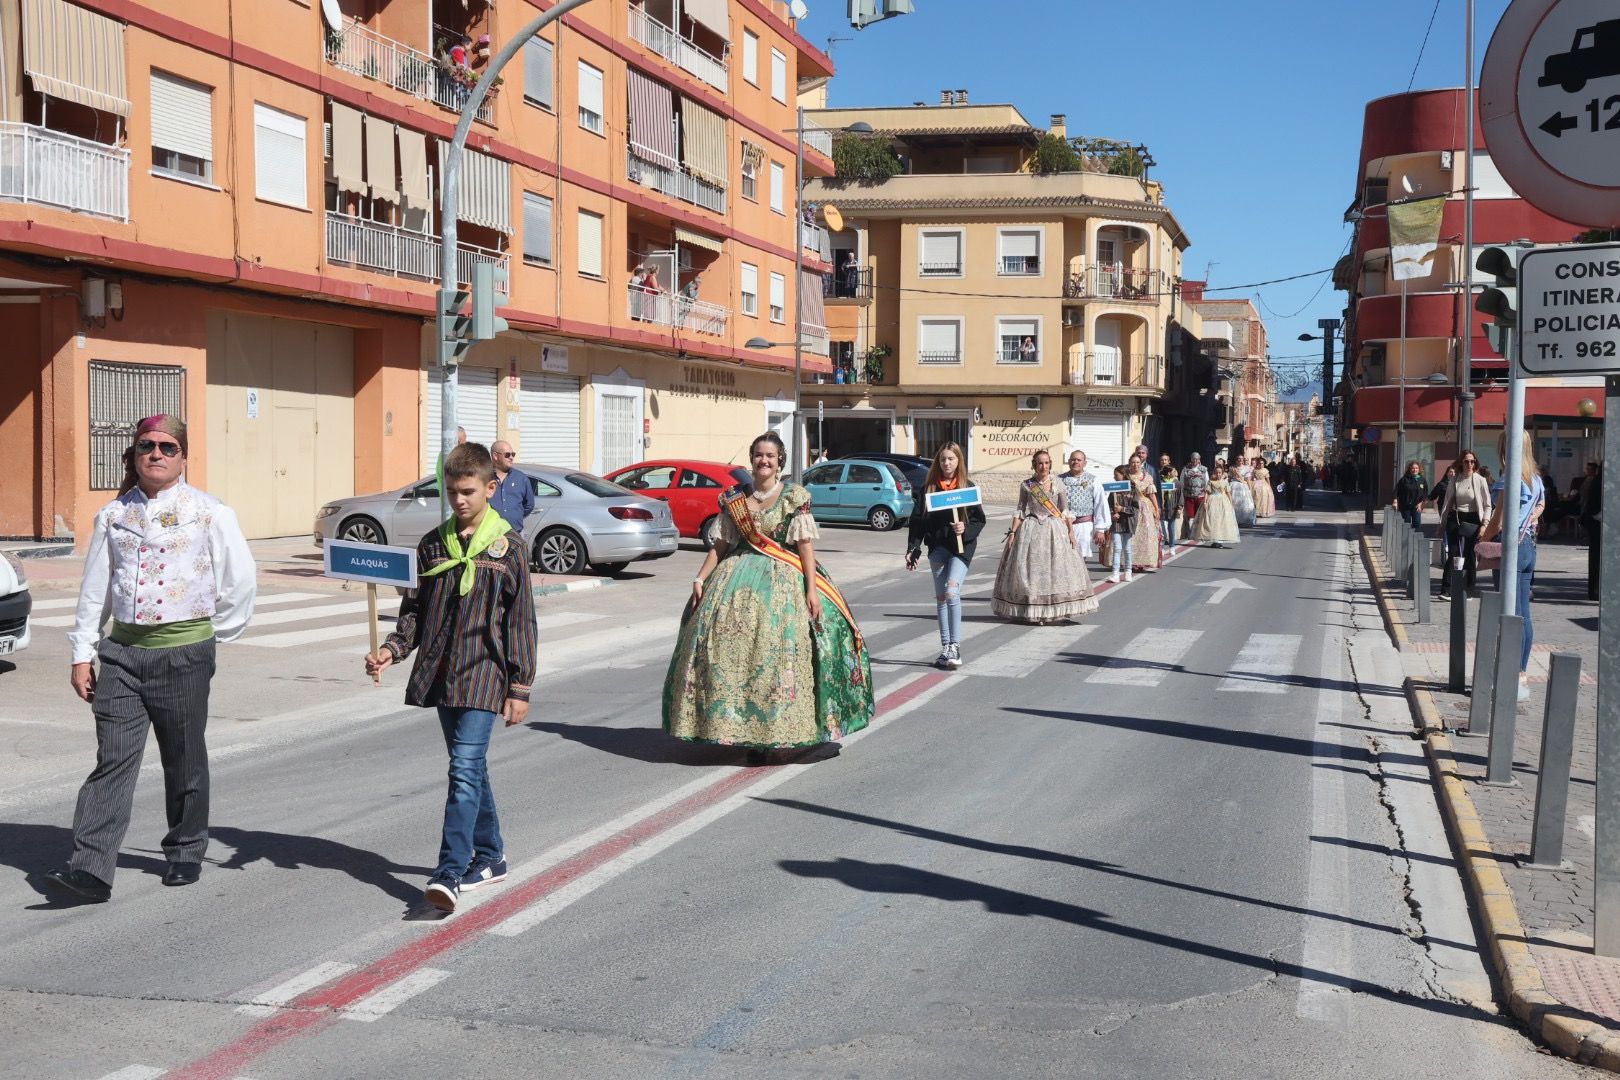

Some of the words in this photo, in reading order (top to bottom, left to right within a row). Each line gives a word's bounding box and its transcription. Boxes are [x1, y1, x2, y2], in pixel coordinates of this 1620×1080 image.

[1585, 94, 1620, 132] 12
[1543, 288, 1620, 306] ITINER
[1534, 314, 1620, 333] POLICIA
[1537, 343, 1562, 359] Tf.
[1576, 341, 1616, 358] 962
[684, 366, 735, 386] TANATORIO
[988, 419, 1032, 427] MUEBLES
[988, 432, 1050, 442] DECORACIÓN
